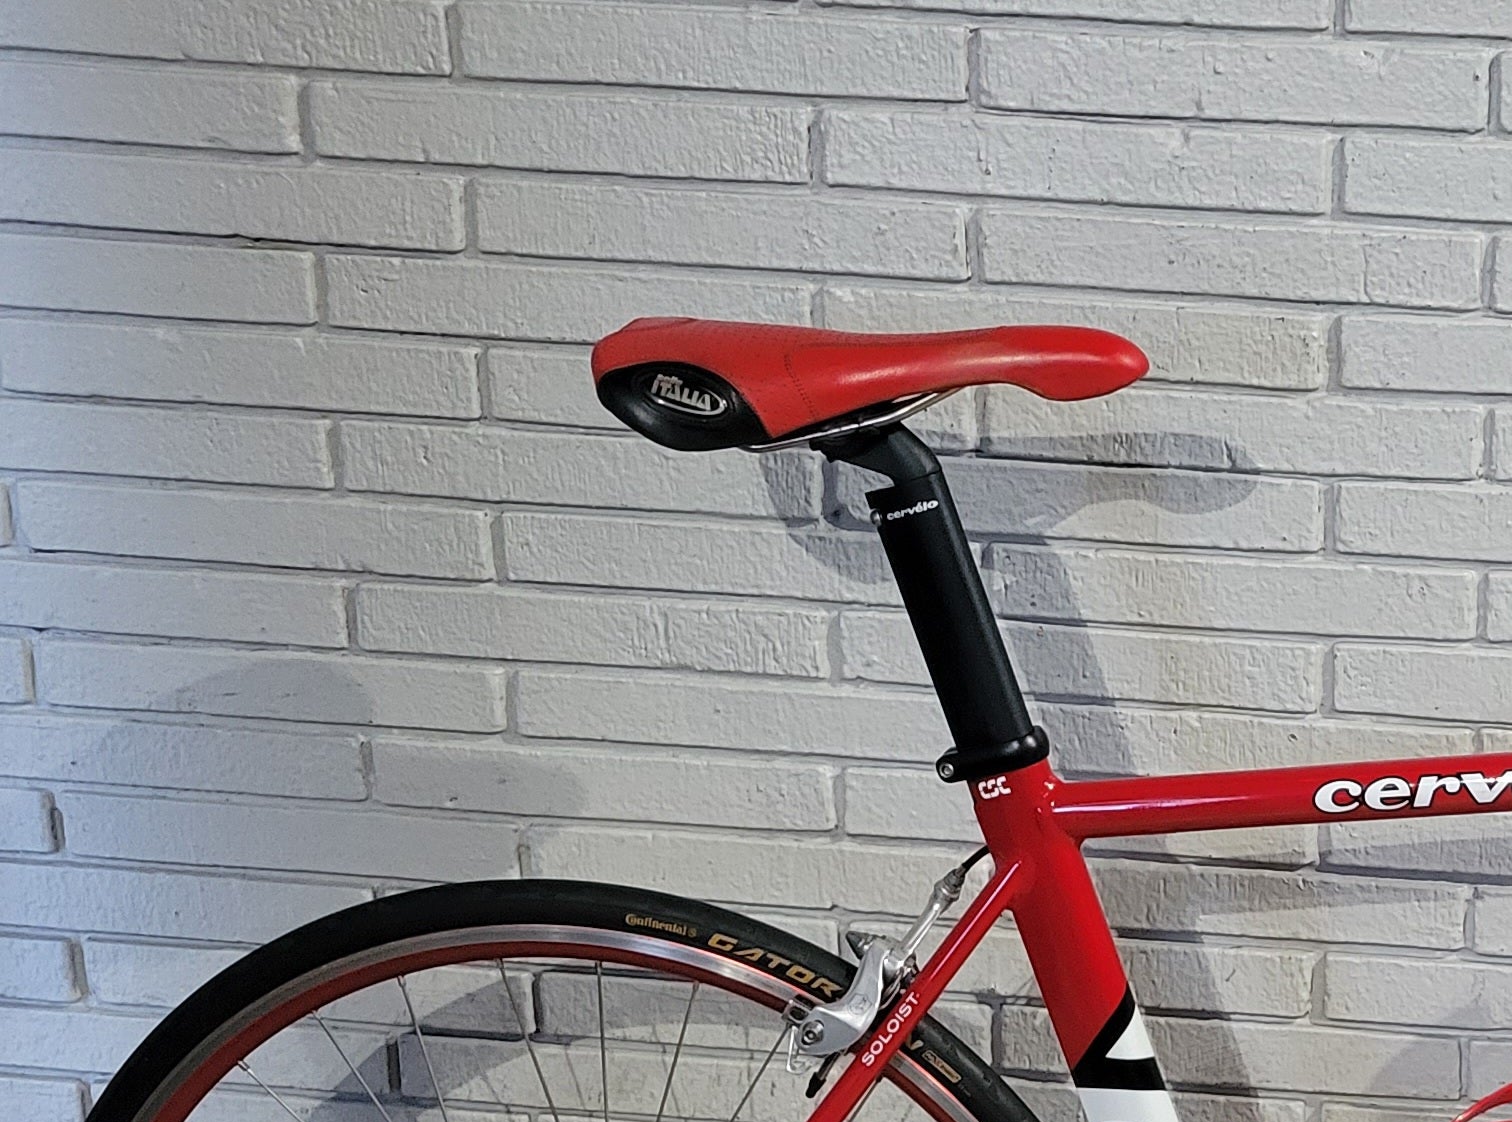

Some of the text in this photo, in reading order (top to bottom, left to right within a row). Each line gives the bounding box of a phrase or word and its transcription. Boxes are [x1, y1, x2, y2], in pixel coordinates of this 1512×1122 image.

[650, 378, 712, 411] ITALIA
[977, 775, 1012, 800] CSC
[624, 913, 688, 937] Continental
[707, 932, 844, 998] GATOR
[861, 991, 919, 1068] SOLOIST
